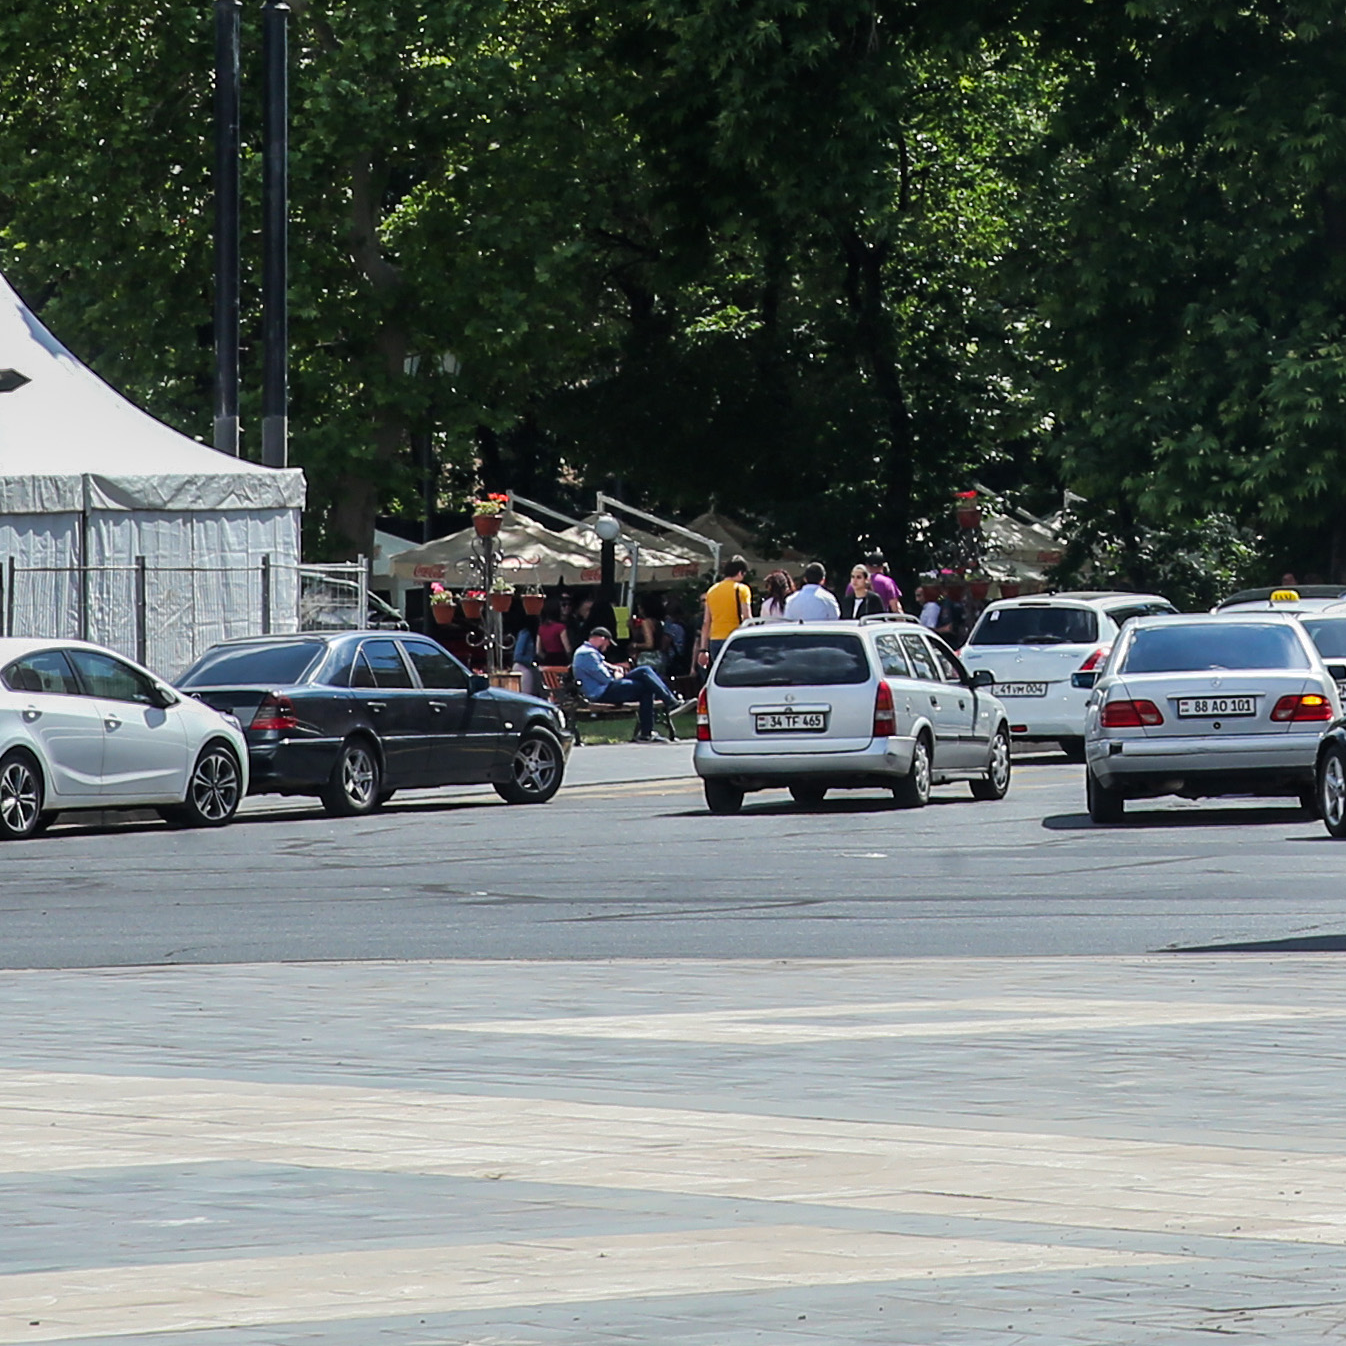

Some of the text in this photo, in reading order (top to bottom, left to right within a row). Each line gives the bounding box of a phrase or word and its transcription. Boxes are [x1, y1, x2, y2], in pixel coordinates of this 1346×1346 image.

[1274, 593, 1294, 601] TAXI
[1194, 700, 1208, 713] 88
[1230, 699, 1251, 712] 101
[770, 715, 821, 727] 34 TF 465
